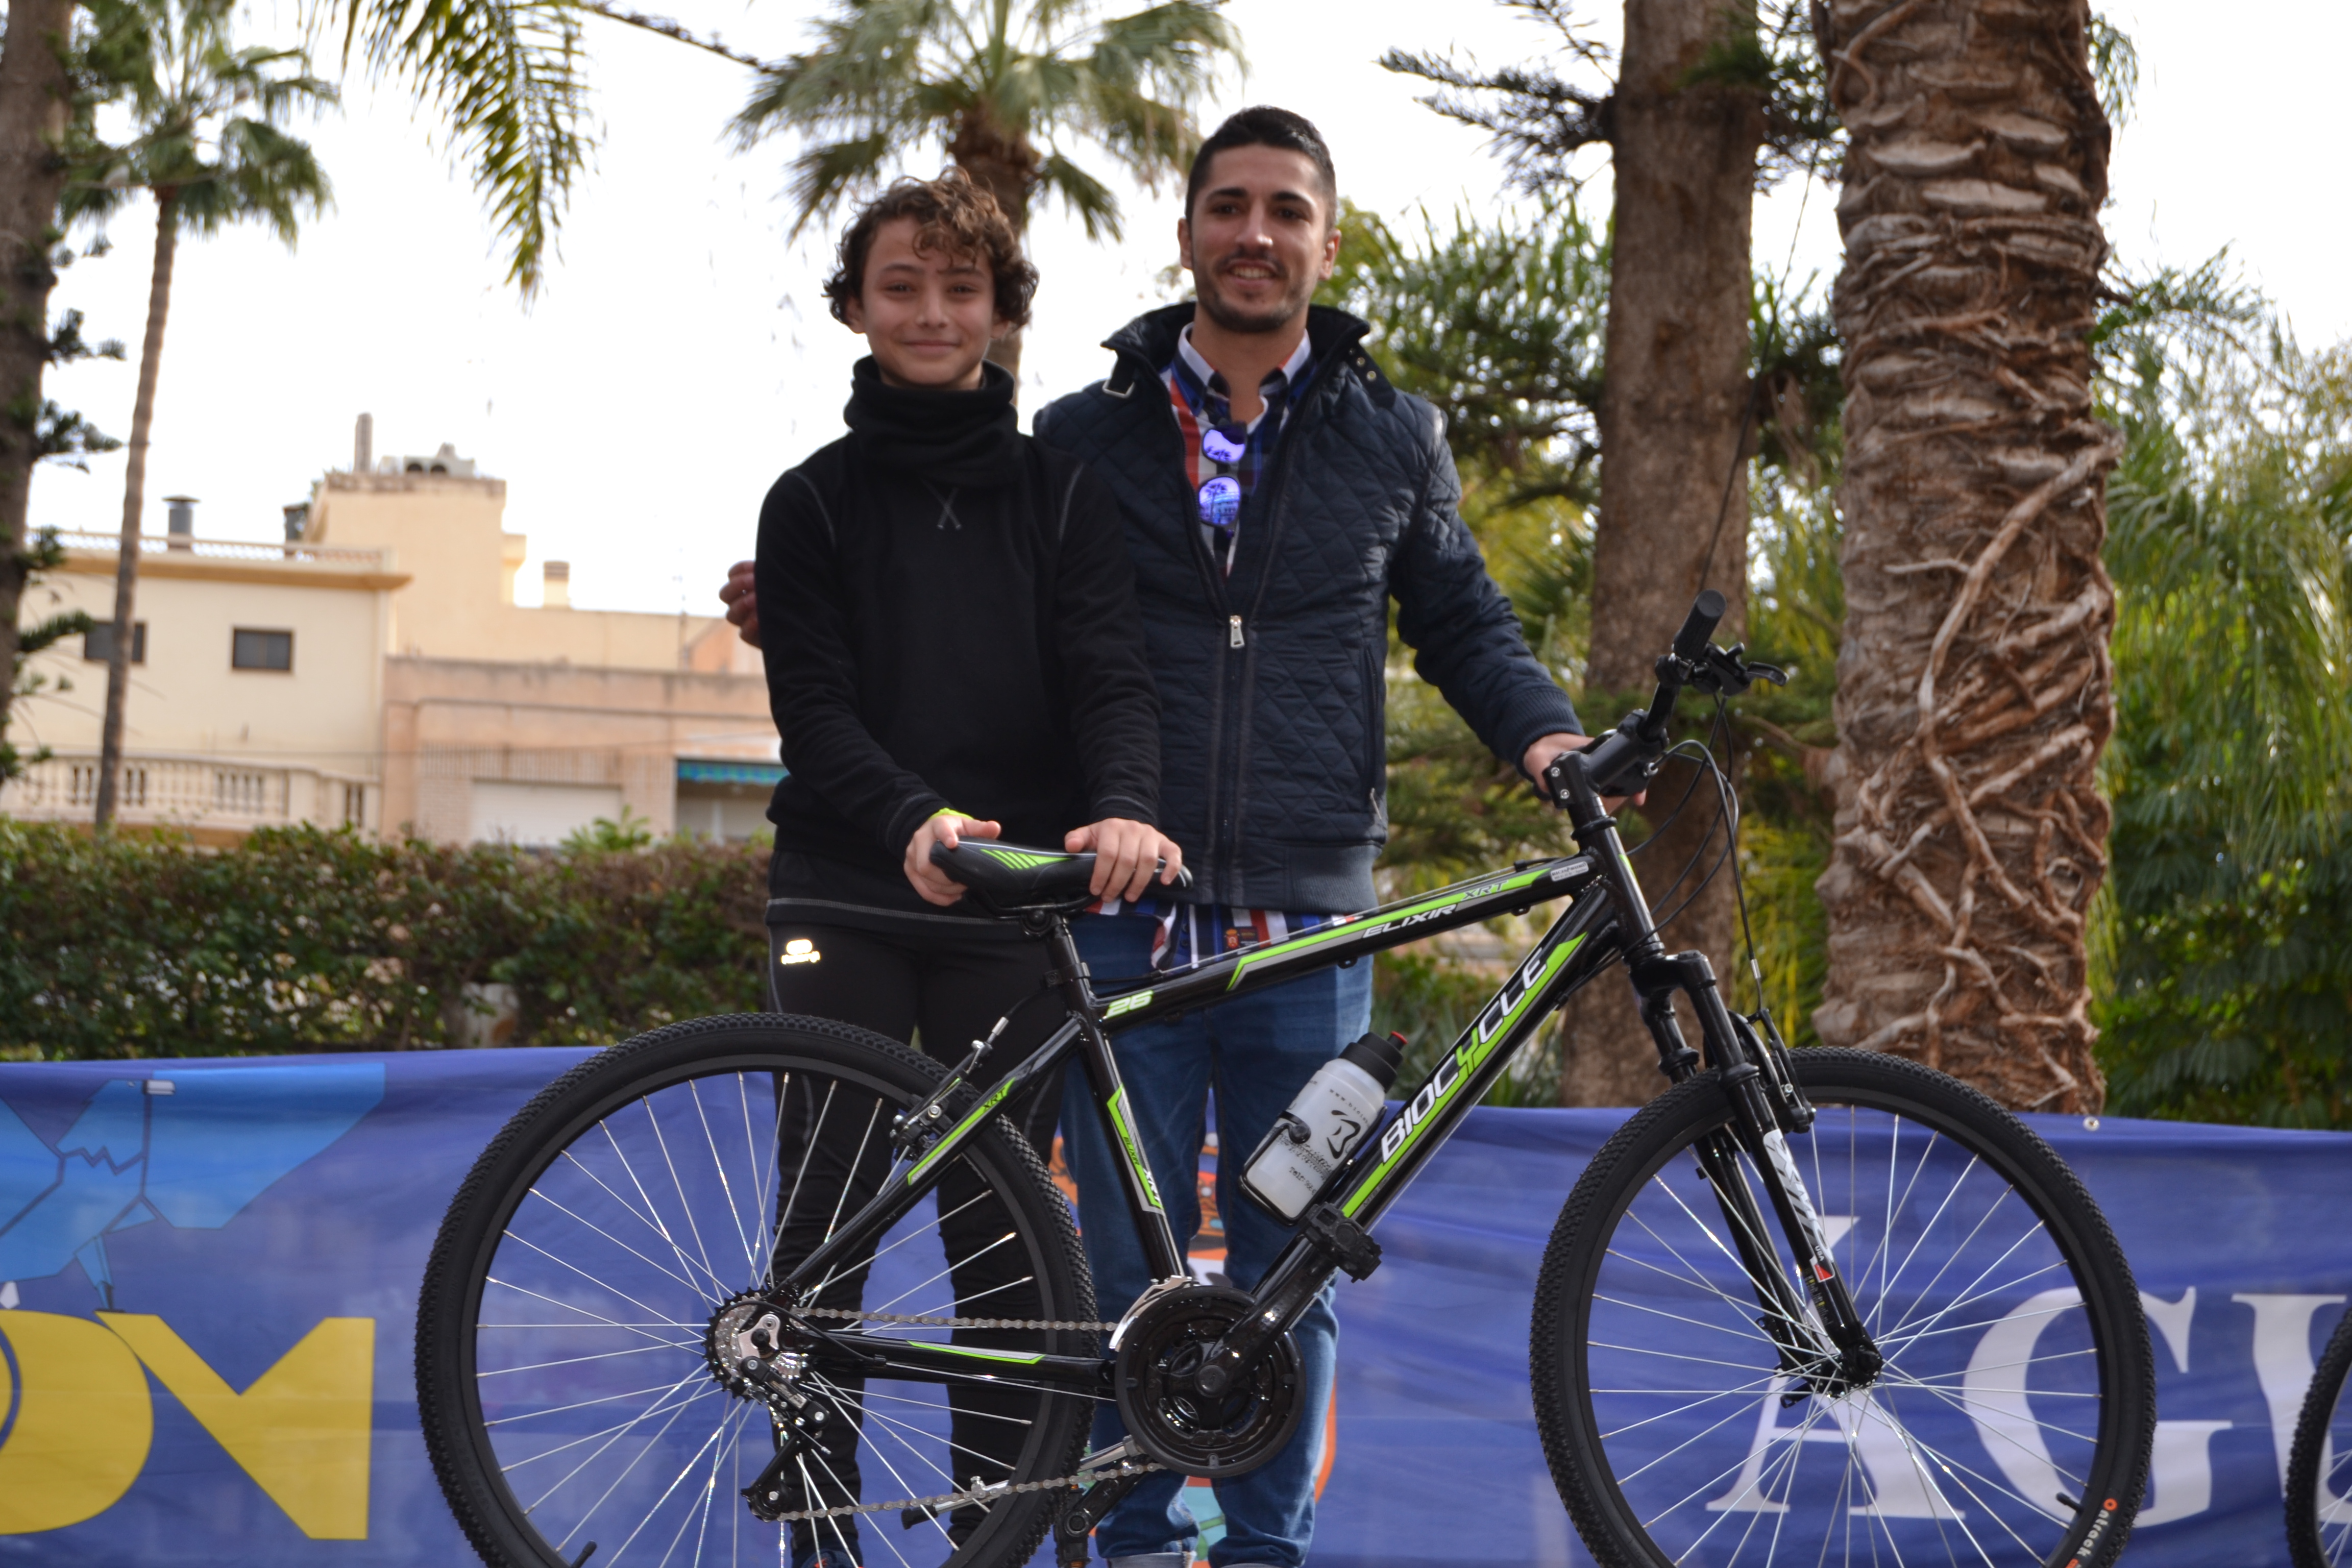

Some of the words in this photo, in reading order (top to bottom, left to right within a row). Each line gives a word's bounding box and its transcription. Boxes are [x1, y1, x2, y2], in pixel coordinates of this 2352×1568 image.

[1362, 904, 1457, 938] ELIXIR
[1460, 879, 1509, 902] XRT
[1105, 990, 1154, 1019] 26
[1381, 947, 1547, 1163] BIOCYCLE
[983, 1087, 1006, 1111] XRT
[1123, 1137, 1140, 1165] ELIXIR
[1815, 1245, 1825, 1262] USA
[2076, 1498, 2118, 1556] Ontrack
